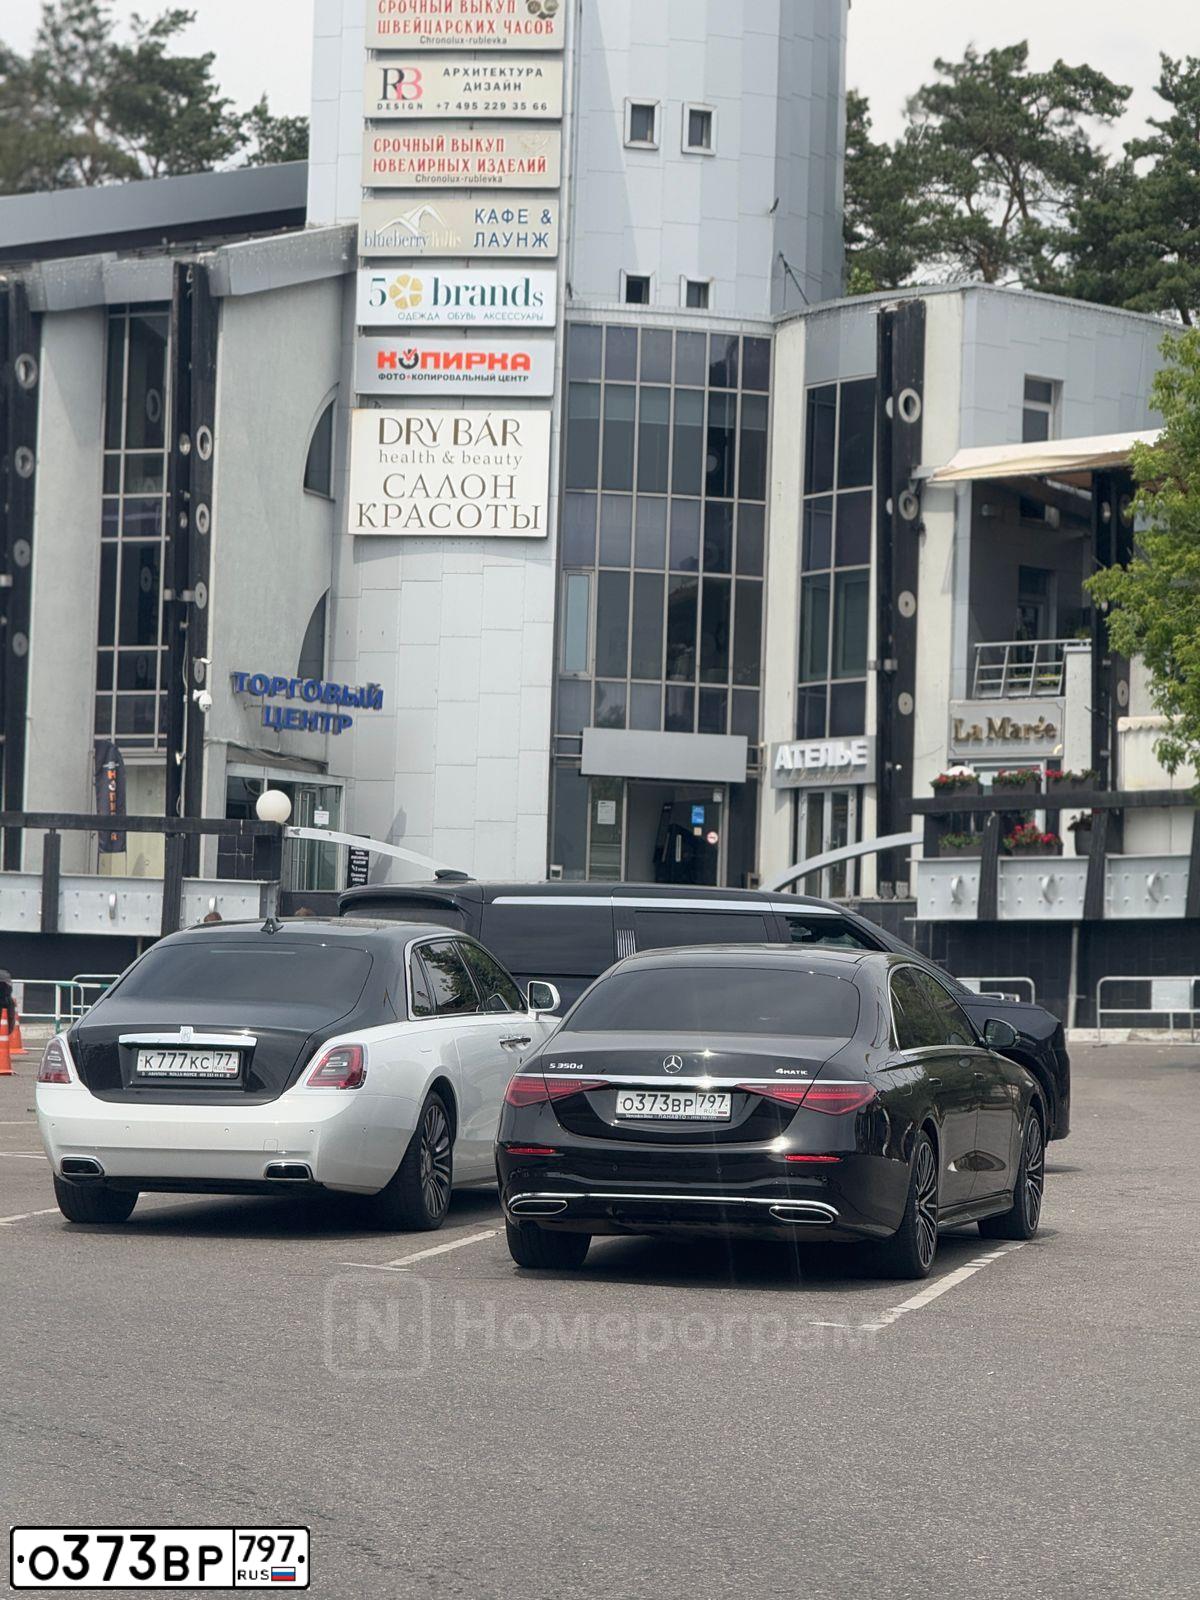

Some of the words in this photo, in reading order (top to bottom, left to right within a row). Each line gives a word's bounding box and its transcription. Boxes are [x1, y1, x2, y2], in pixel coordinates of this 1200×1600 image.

[460, 0, 515, 13] ВЫКУП
[377, 17, 496, 35] ШВЕЙЦАРСКИХ
[504, 20, 554, 34] ЧАСОВ
[419, 36, 507, 45] Chronolux-rublevka
[443, 67, 543, 78] АРХИТЕКТУРА
[463, 81, 522, 92] ДИЗАЙН
[436, 102, 450, 110] +7
[456, 102, 478, 110] 495
[484, 102, 506, 110] 229
[512, 102, 527, 110] 35
[533, 102, 548, 111] 66
[374, 135, 445, 152] СРОЧНЫЙ
[451, 138, 505, 152] ВЫКУП
[373, 158, 470, 173] ЮВЕЛИРНЫХ
[477, 156, 547, 173] ИЗДЕЛИЙ
[415, 174, 503, 184] Chronolux-rublevka
[474, 208, 528, 225] КАФЕ
[541, 209, 552, 225] &
[364, 229, 428, 252] blueberry
[473, 232, 549, 248] ЛАУНЖ
[432, 277, 544, 307] brands
[397, 312, 440, 321] ОДЕЖДА
[447, 312, 476, 321] ОБУВЬ
[483, 312, 544, 321] АКСЕССУАРЫ
[377, 347, 531, 371] КОПИРКА
[498, 374, 529, 383] ЦЕНТР
[379, 417, 444, 448] DRY
[453, 412, 523, 447] BÁR
[379, 449, 435, 464] health
[442, 451, 454, 464] &
[462, 451, 523, 469] beauty
[382, 473, 518, 500] САЛОН
[356, 503, 542, 530] КРАСОТЫ
[230, 671, 384, 711] ТОРГОВЫЙ
[262, 704, 353, 735] ЦЕНТР
[953, 717, 982, 741] La
[774, 740, 868, 770] АТЕЛЬЕ
[144, 1052, 210, 1069] К777КС
[215, 1053, 232, 1066] 77
[623, 1093, 694, 1112] О373ВР
[698, 1094, 726, 1108] 797
